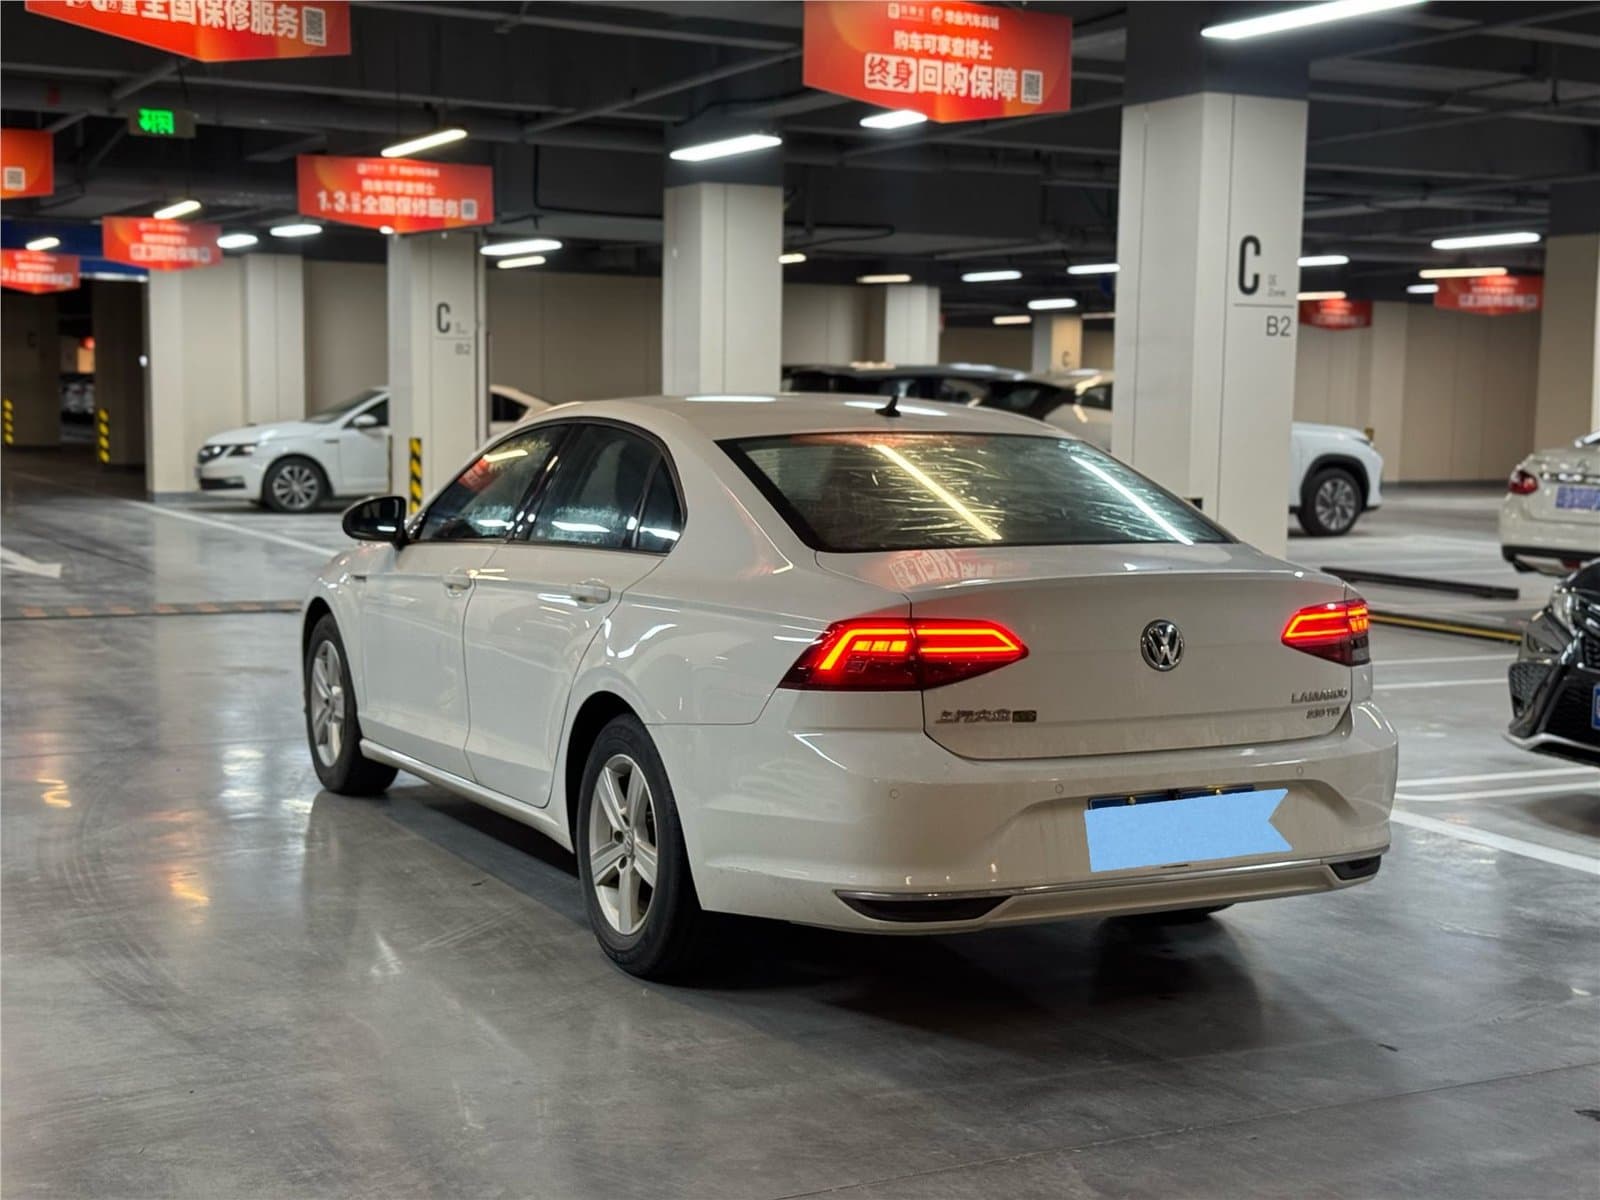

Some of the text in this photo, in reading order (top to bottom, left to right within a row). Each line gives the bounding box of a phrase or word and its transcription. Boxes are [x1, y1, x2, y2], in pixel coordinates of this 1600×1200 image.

[866, 54, 1018, 101] 终身回购保障
[1238, 234, 1261, 296] C
[436, 302, 451, 334] C
[1266, 315, 1291, 337] B2
